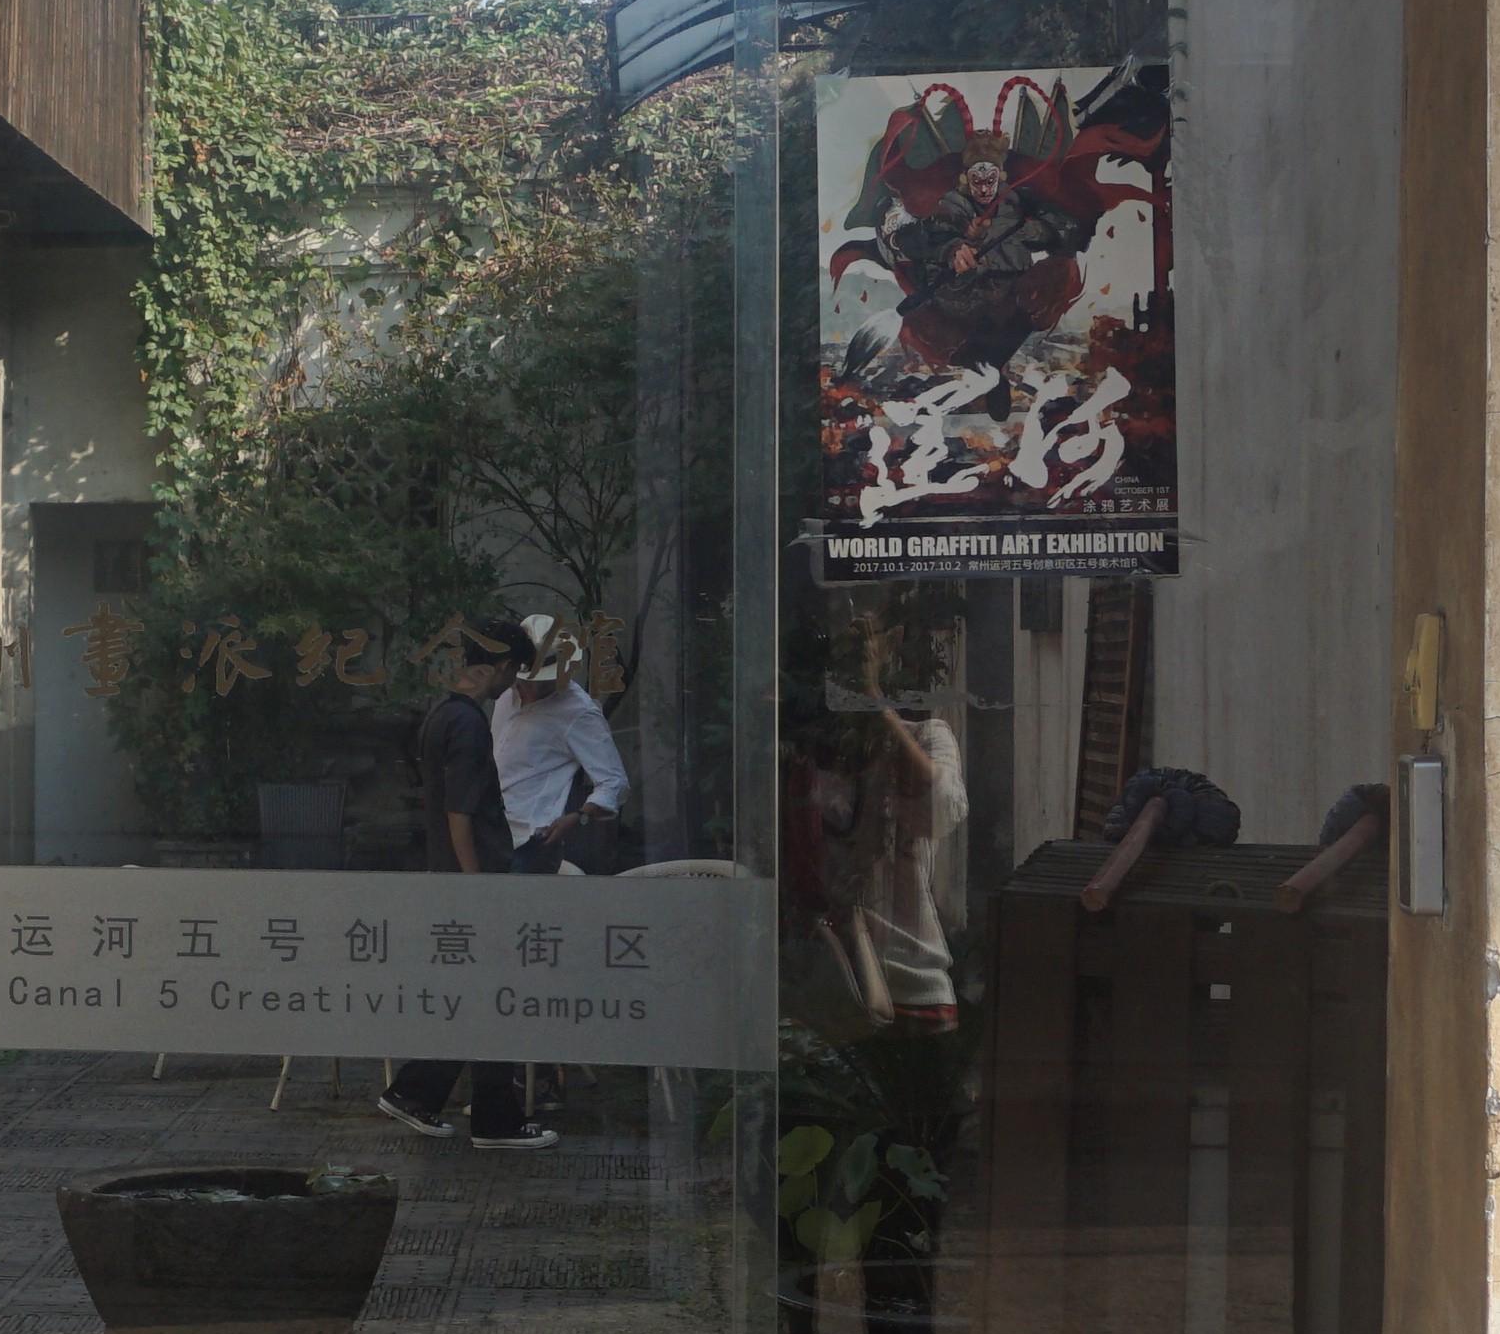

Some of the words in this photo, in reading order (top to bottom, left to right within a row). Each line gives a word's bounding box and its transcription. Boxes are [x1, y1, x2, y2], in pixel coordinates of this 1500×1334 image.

[1114, 475, 1140, 484] CHINA
[1114, 486, 1154, 495] OCTOBER
[1083, 498, 1169, 512] 涂鸦艺术展
[827, 538, 902, 558] WORLD
[907, 535, 998, 557] GRAFFITI
[1001, 534, 1043, 555] ART
[1046, 531, 1165, 555] EXHIBITION
[853, 560, 961, 573] 2017.10.1-2017.10.2
[9, 912, 652, 971] 运河五号创意街区
[8, 976, 124, 1009] Canal
[158, 979, 180, 1010] 5
[210, 978, 463, 1022] Creativity
[495, 986, 648, 1025] Campus
